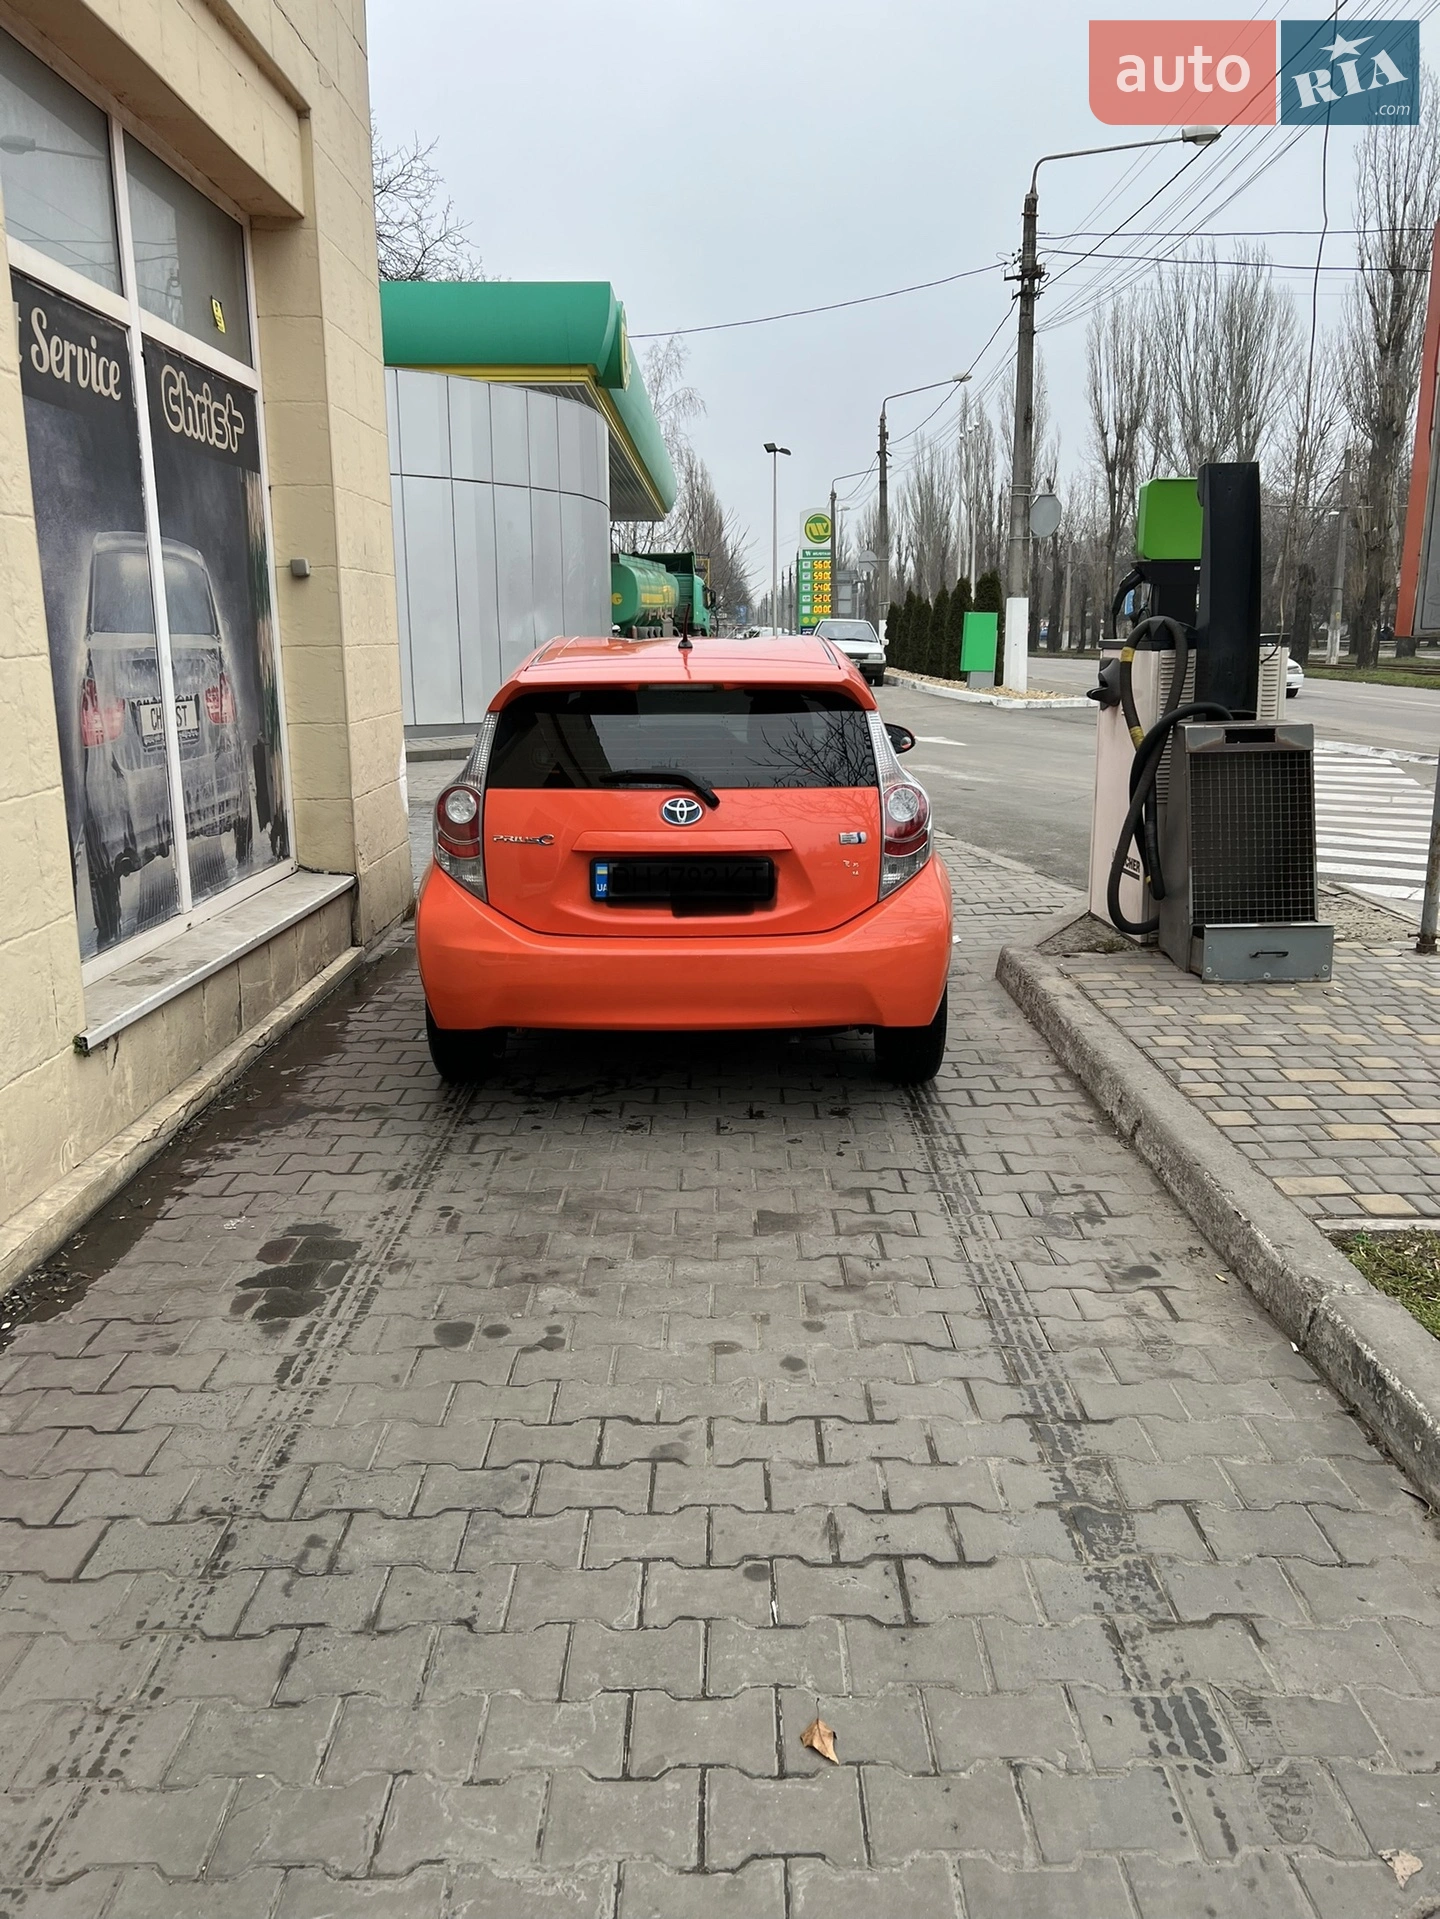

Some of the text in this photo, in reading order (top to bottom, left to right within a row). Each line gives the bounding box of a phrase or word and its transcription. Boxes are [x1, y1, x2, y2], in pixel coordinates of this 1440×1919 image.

[30, 307, 121, 401] Service
[161, 365, 244, 453] Christ
[150, 705, 187, 730] CHST
